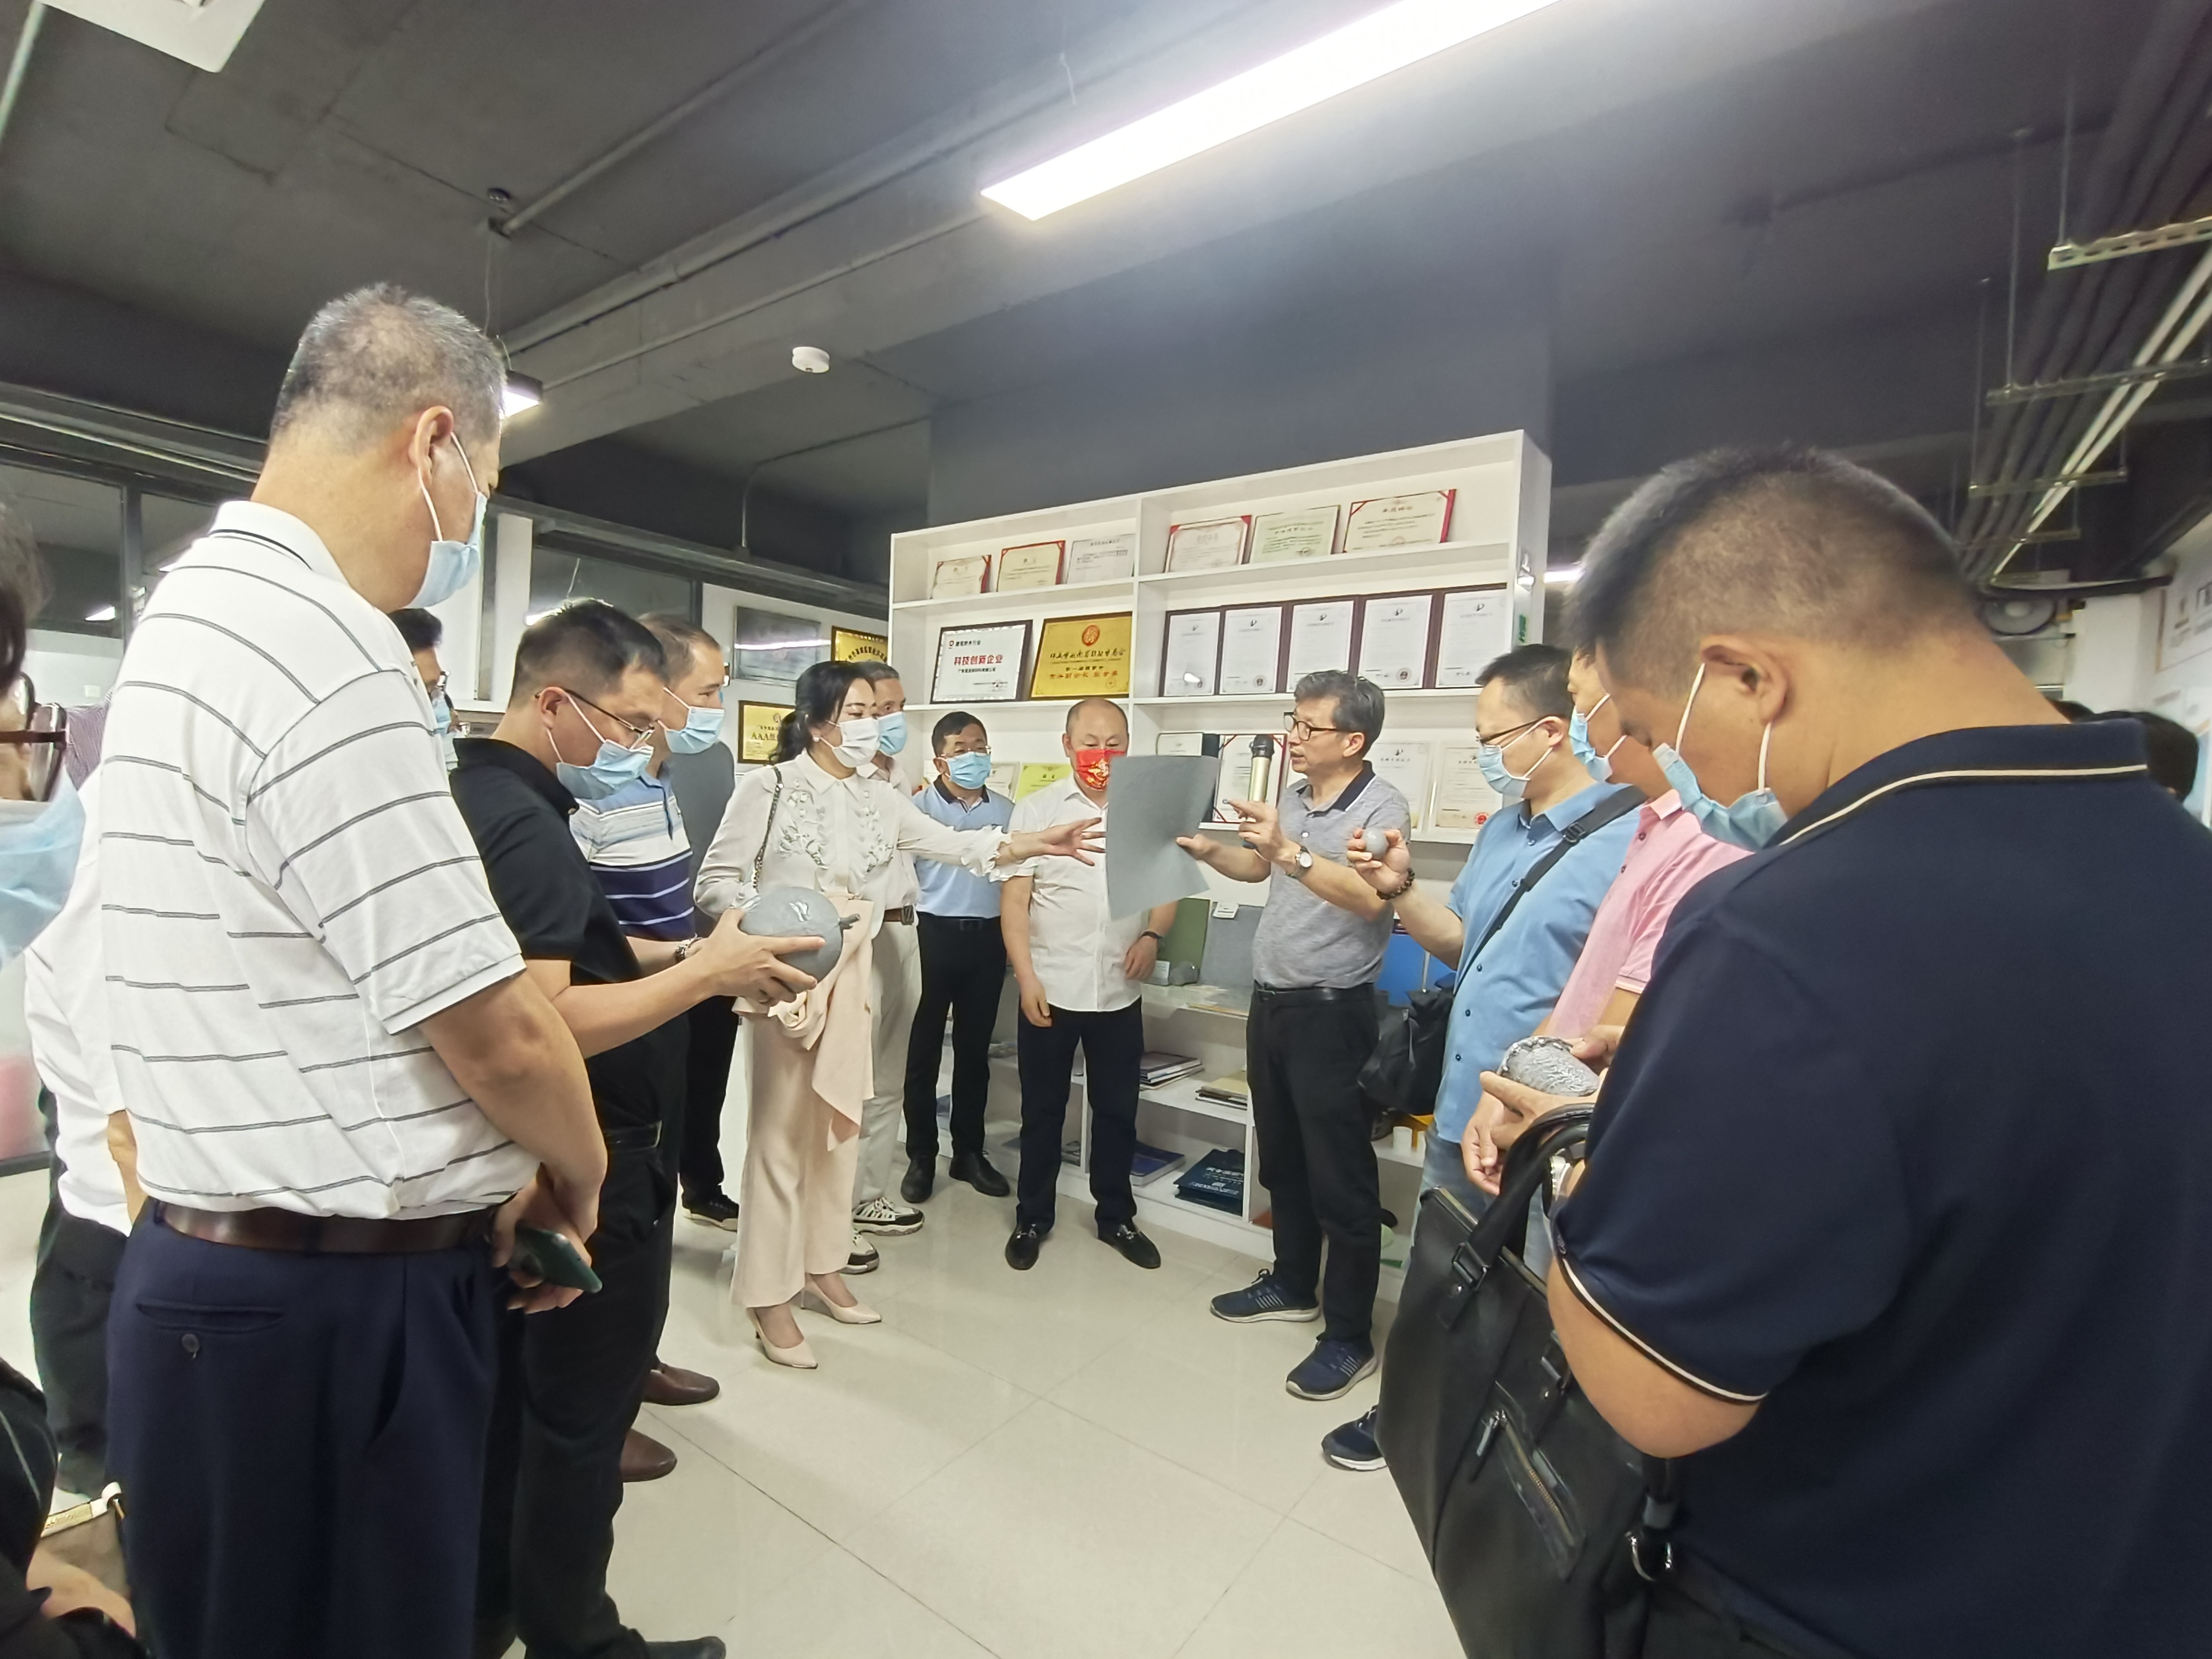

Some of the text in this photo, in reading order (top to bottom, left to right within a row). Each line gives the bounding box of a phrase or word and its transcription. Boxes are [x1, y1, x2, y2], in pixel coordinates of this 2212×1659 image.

[954, 655, 1003, 665] 科技创新企业
